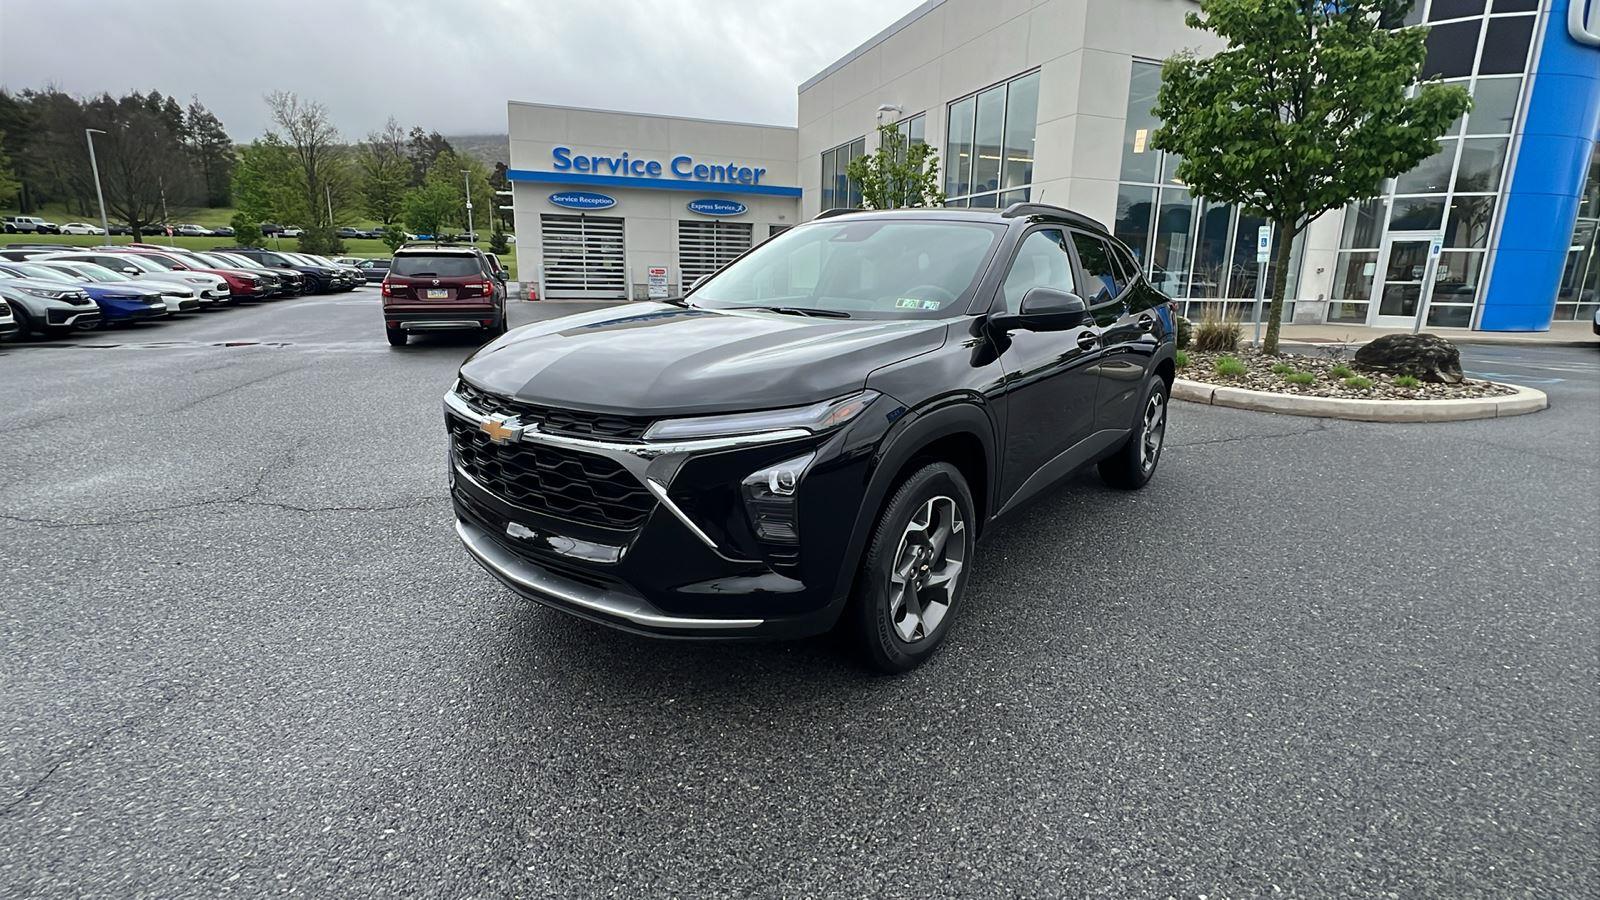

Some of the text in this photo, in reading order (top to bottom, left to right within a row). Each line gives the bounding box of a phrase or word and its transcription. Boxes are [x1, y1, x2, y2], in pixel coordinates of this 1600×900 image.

[552, 146, 766, 184] Service Center
[552, 195, 612, 205] Service Reception
[691, 203, 713, 211] Express
